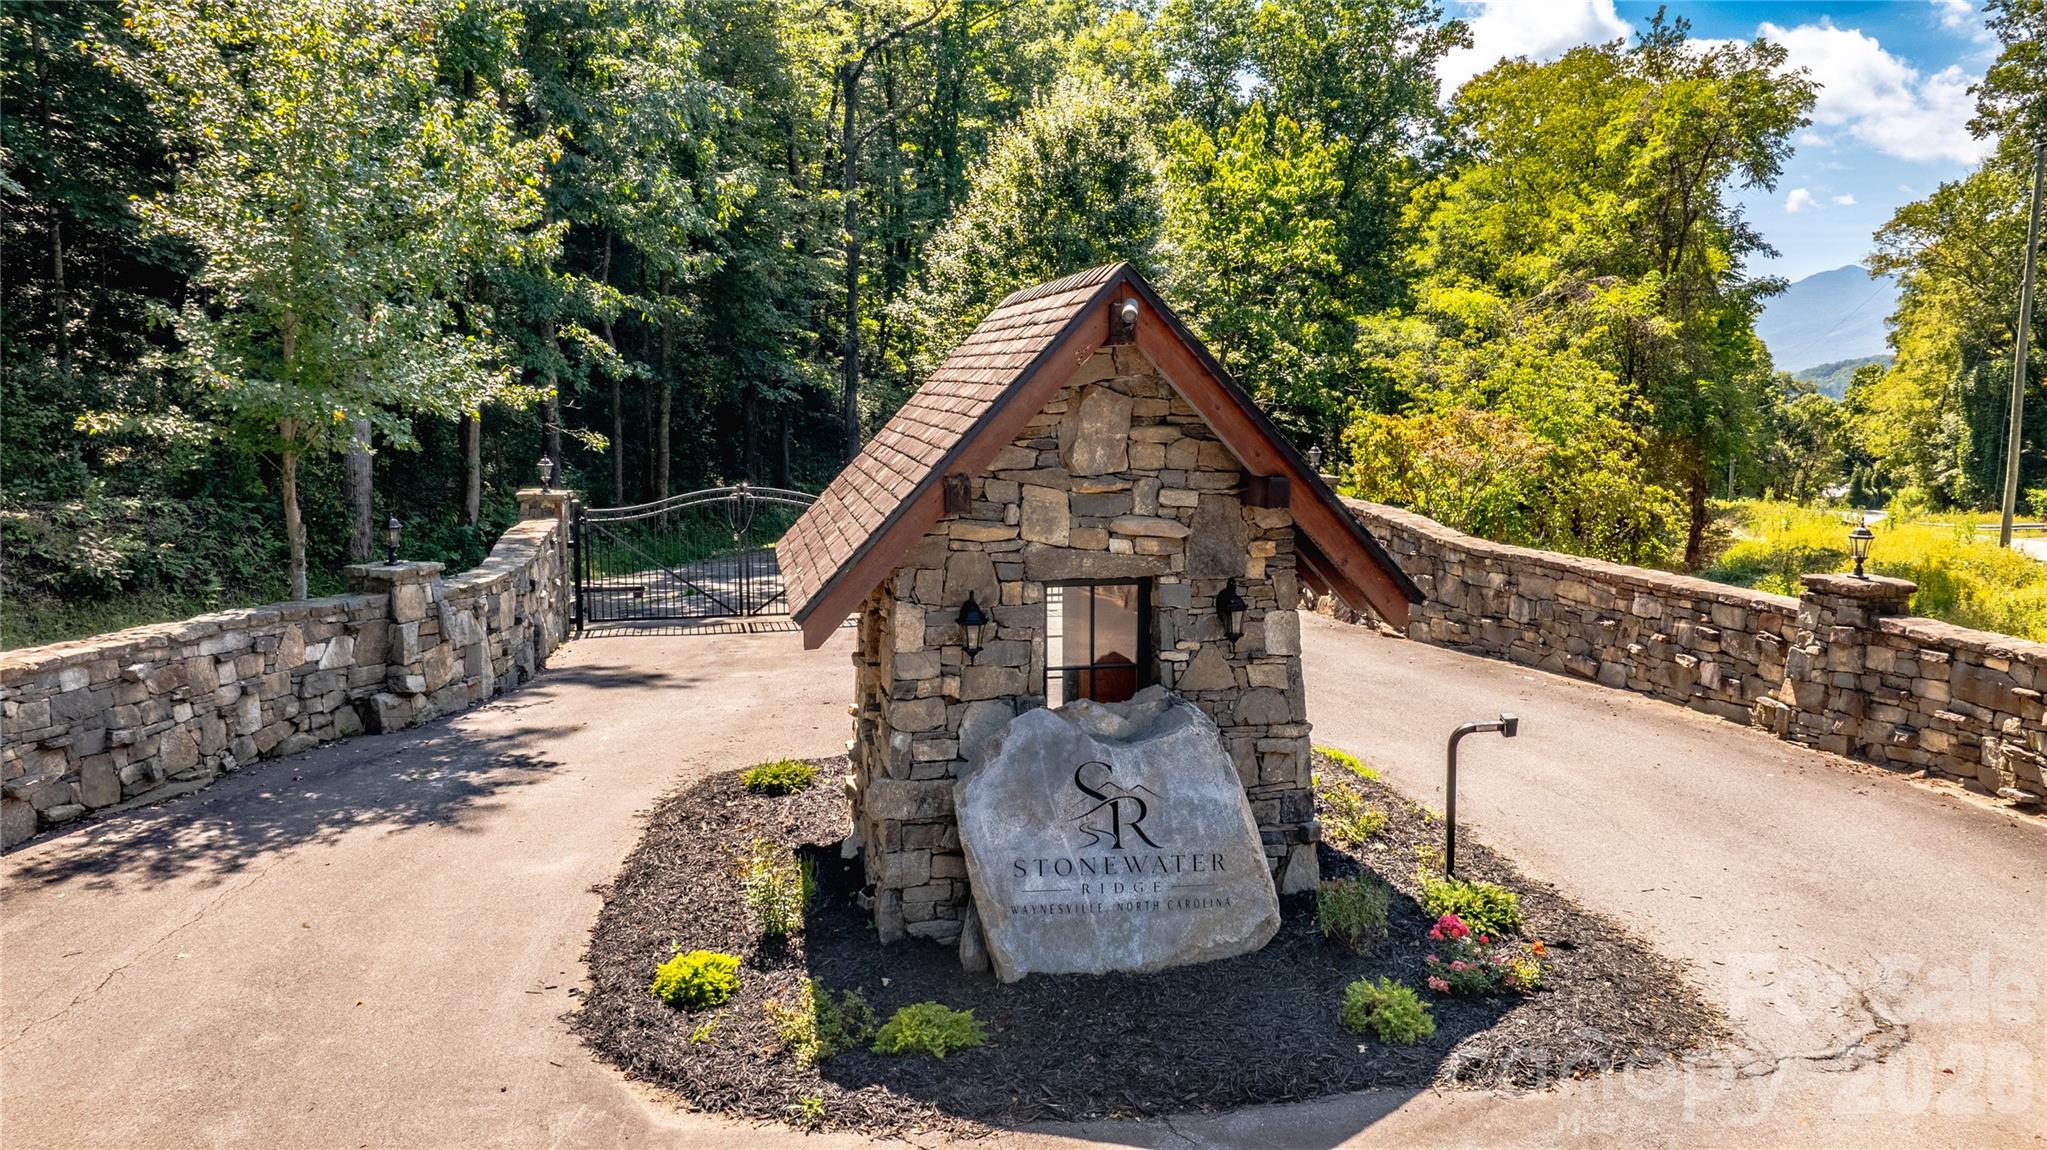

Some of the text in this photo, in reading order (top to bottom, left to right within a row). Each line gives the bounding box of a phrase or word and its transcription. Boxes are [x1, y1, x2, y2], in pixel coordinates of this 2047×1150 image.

[1013, 853, 1226, 878] STONEWATER
[1081, 881, 1161, 895] RIDGE
[1117, 900, 1159, 912] NORTH
[1167, 898, 1231, 910] CAROLINA
